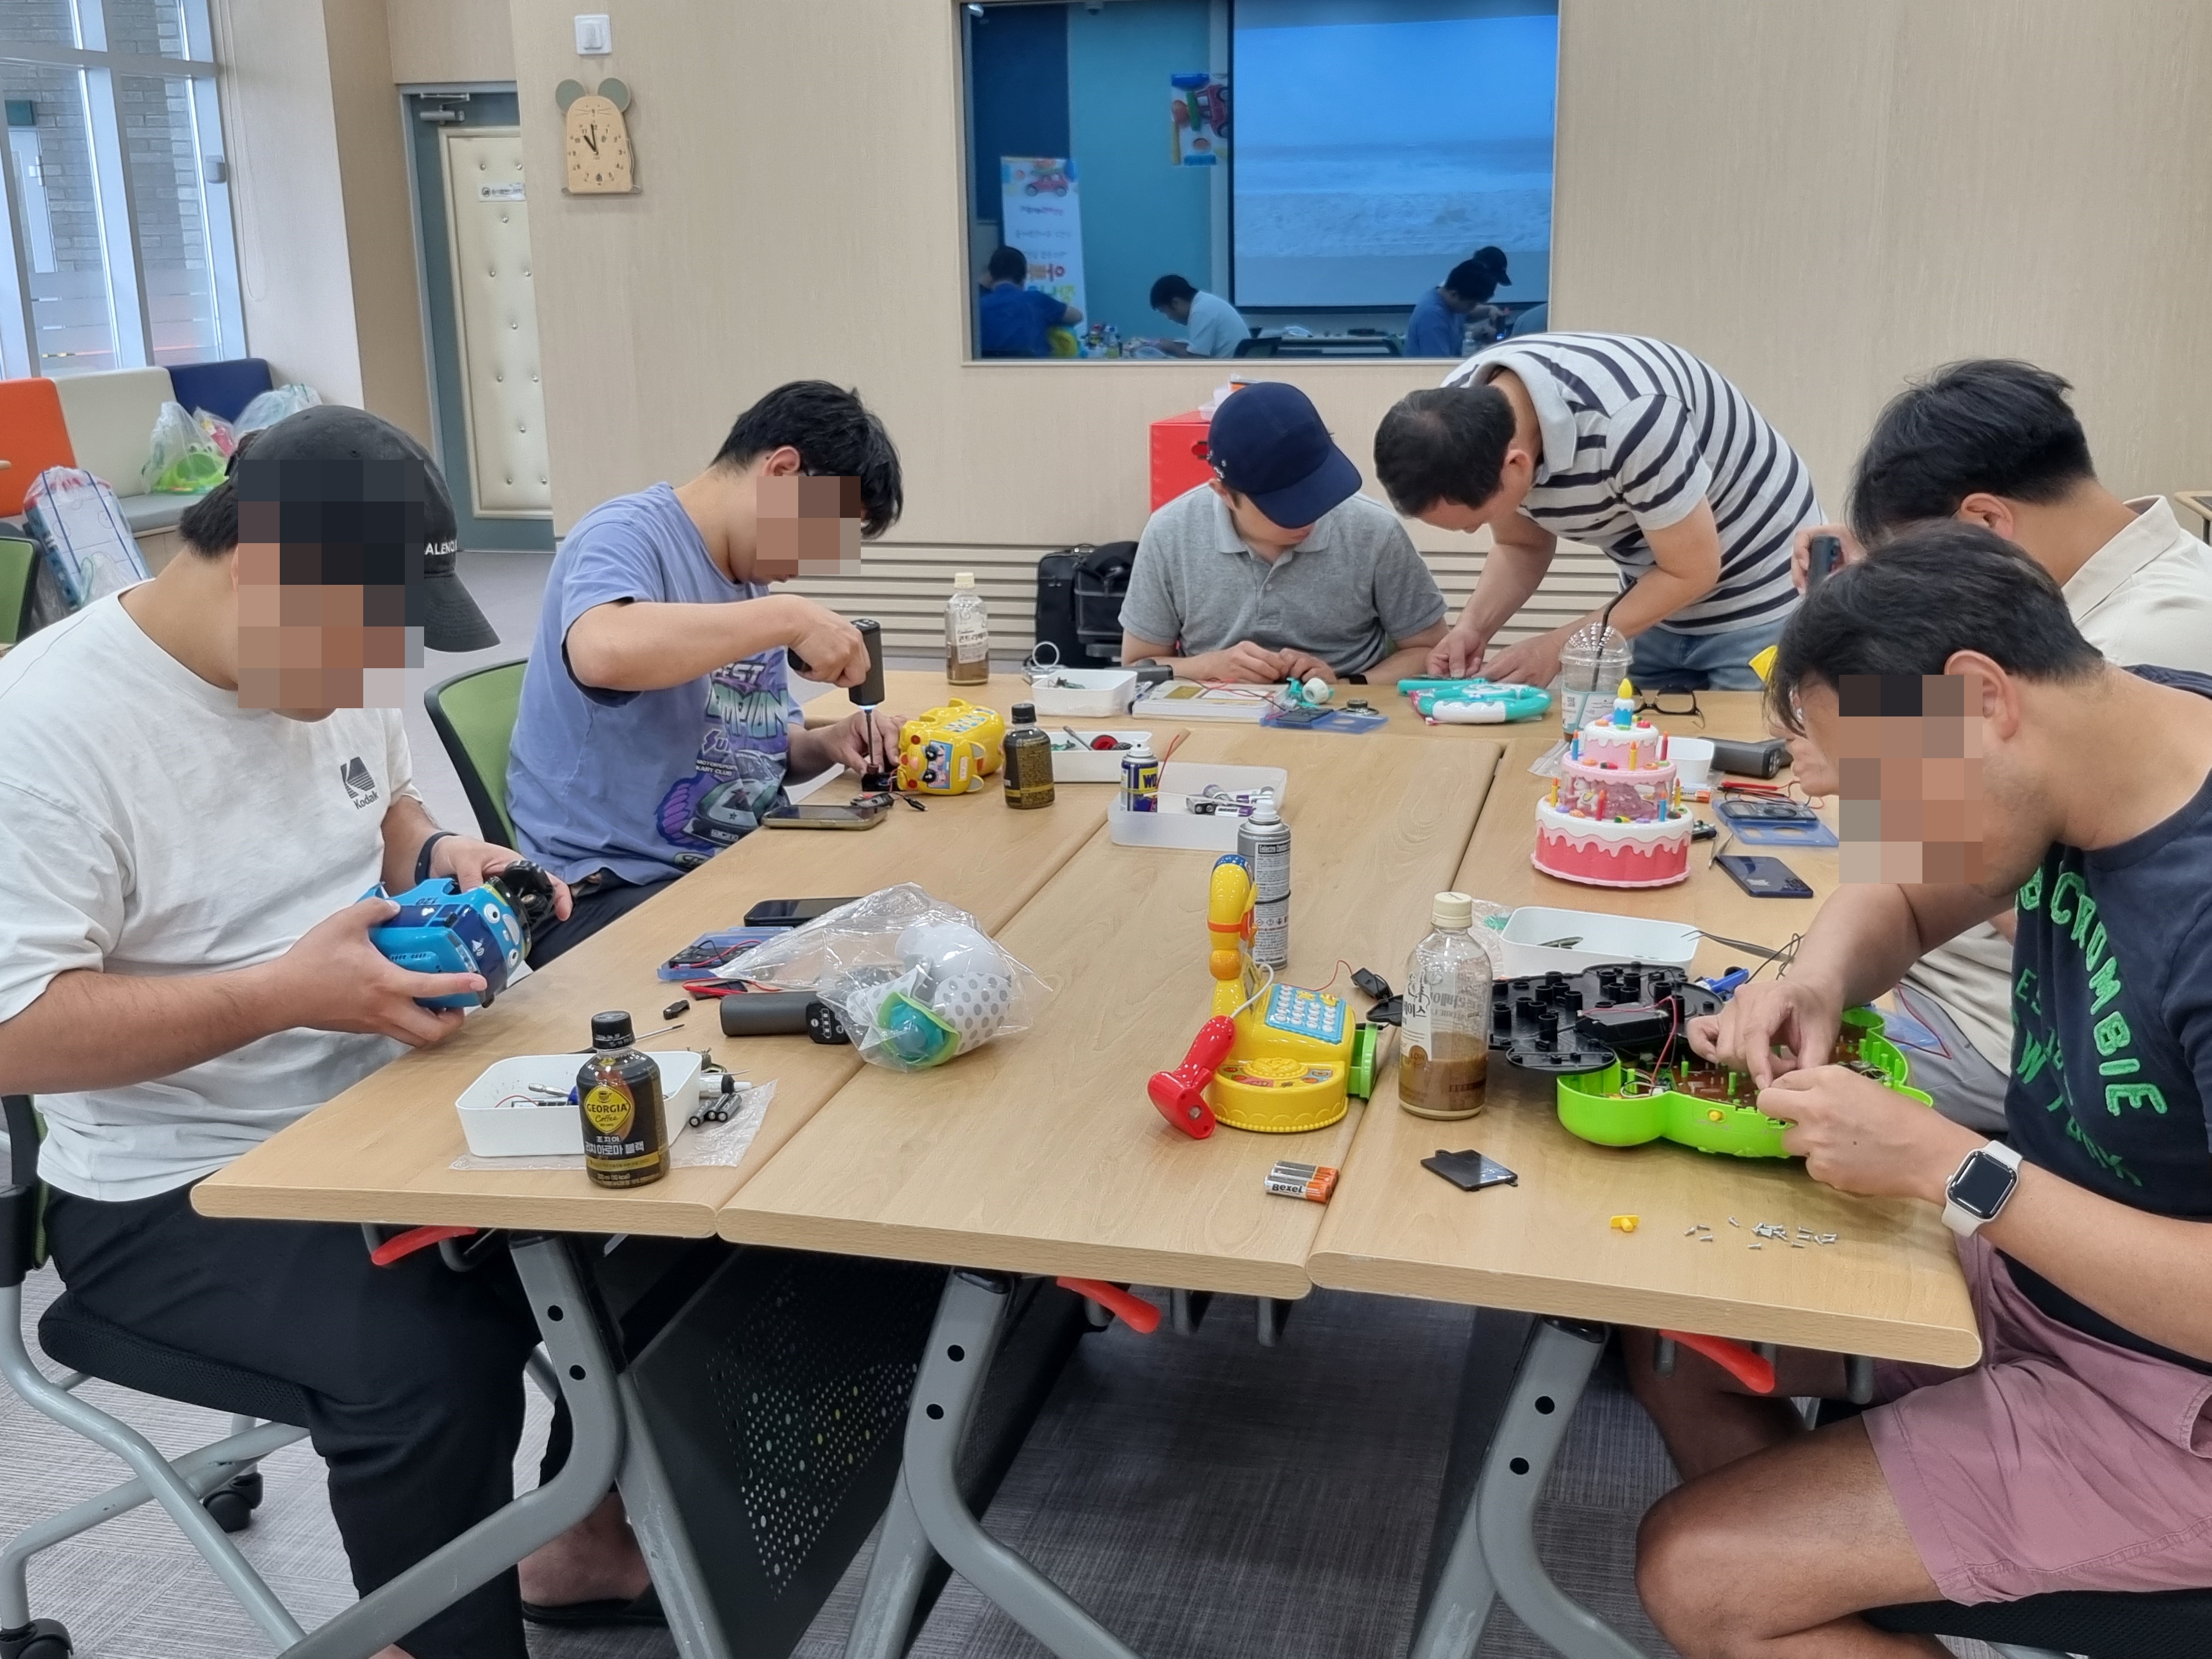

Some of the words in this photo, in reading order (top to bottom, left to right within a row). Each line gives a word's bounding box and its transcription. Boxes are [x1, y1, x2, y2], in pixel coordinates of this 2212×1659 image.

[425, 539, 457, 555] ALENCI
[696, 765, 714, 774] KART
[714, 768, 732, 776] CLUB
[353, 791, 379, 810] Kodak
[587, 1103, 628, 1113] GEORGIA
[595, 1114, 619, 1122] Coffee
[1272, 1184, 1304, 1193] Bexel
